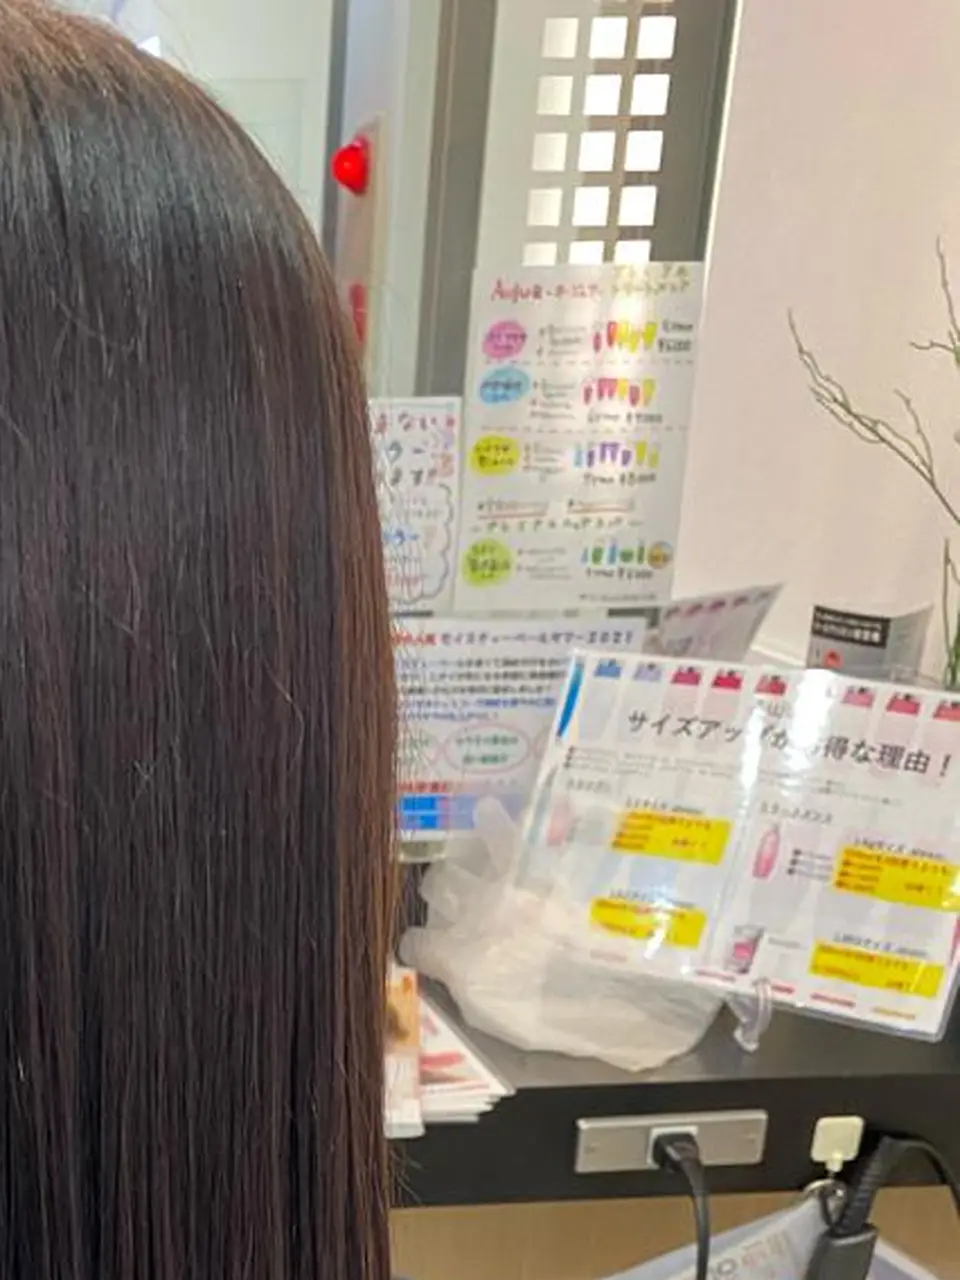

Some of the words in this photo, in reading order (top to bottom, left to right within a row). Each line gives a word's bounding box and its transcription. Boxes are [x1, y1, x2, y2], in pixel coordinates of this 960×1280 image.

[628, 711, 952, 777] サイズアッが得な理由！
